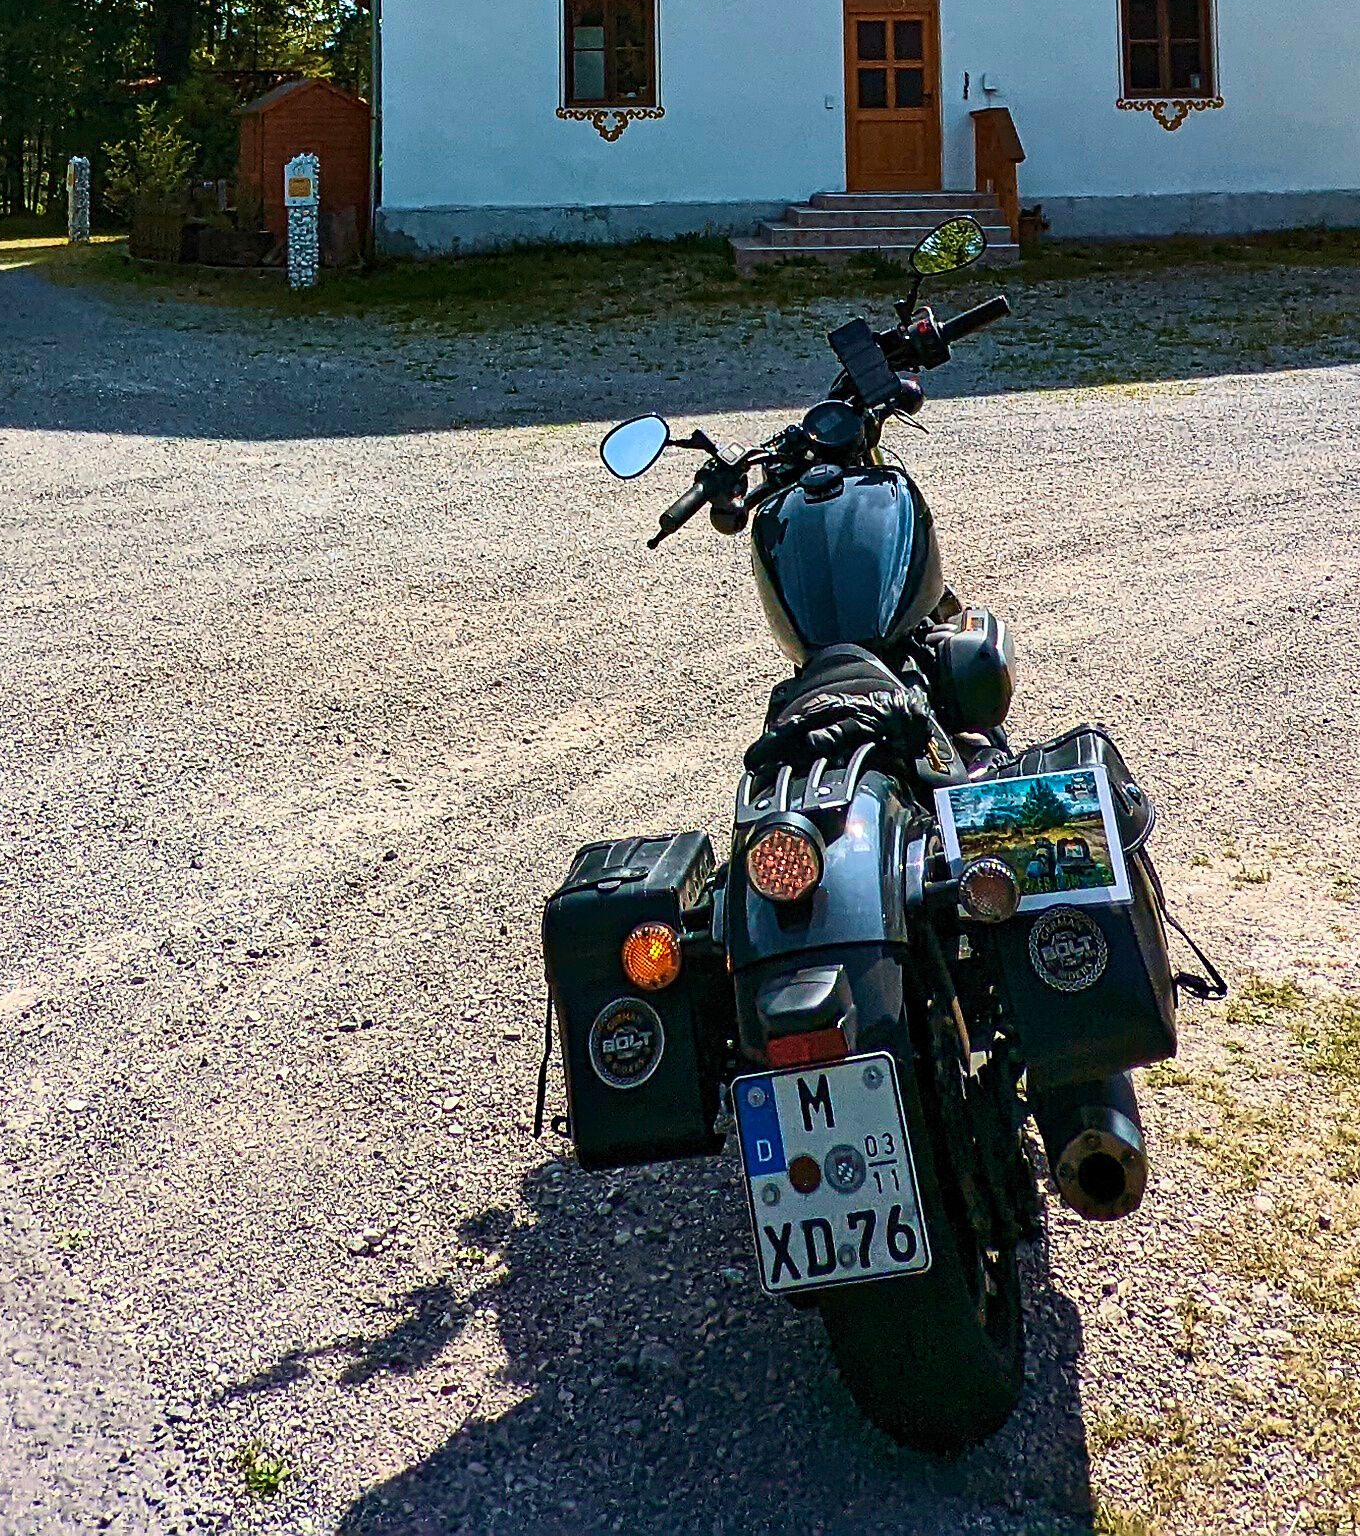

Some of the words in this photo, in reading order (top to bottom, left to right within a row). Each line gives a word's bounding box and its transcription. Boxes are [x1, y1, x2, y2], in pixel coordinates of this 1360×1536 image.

[1041, 935, 1092, 962] BOLT
[602, 1030, 653, 1054] BOLT
[796, 1073, 836, 1132] M
[756, 1138, 773, 1163] D
[863, 1132, 896, 1158] 03
[872, 1168, 900, 1194] 11
